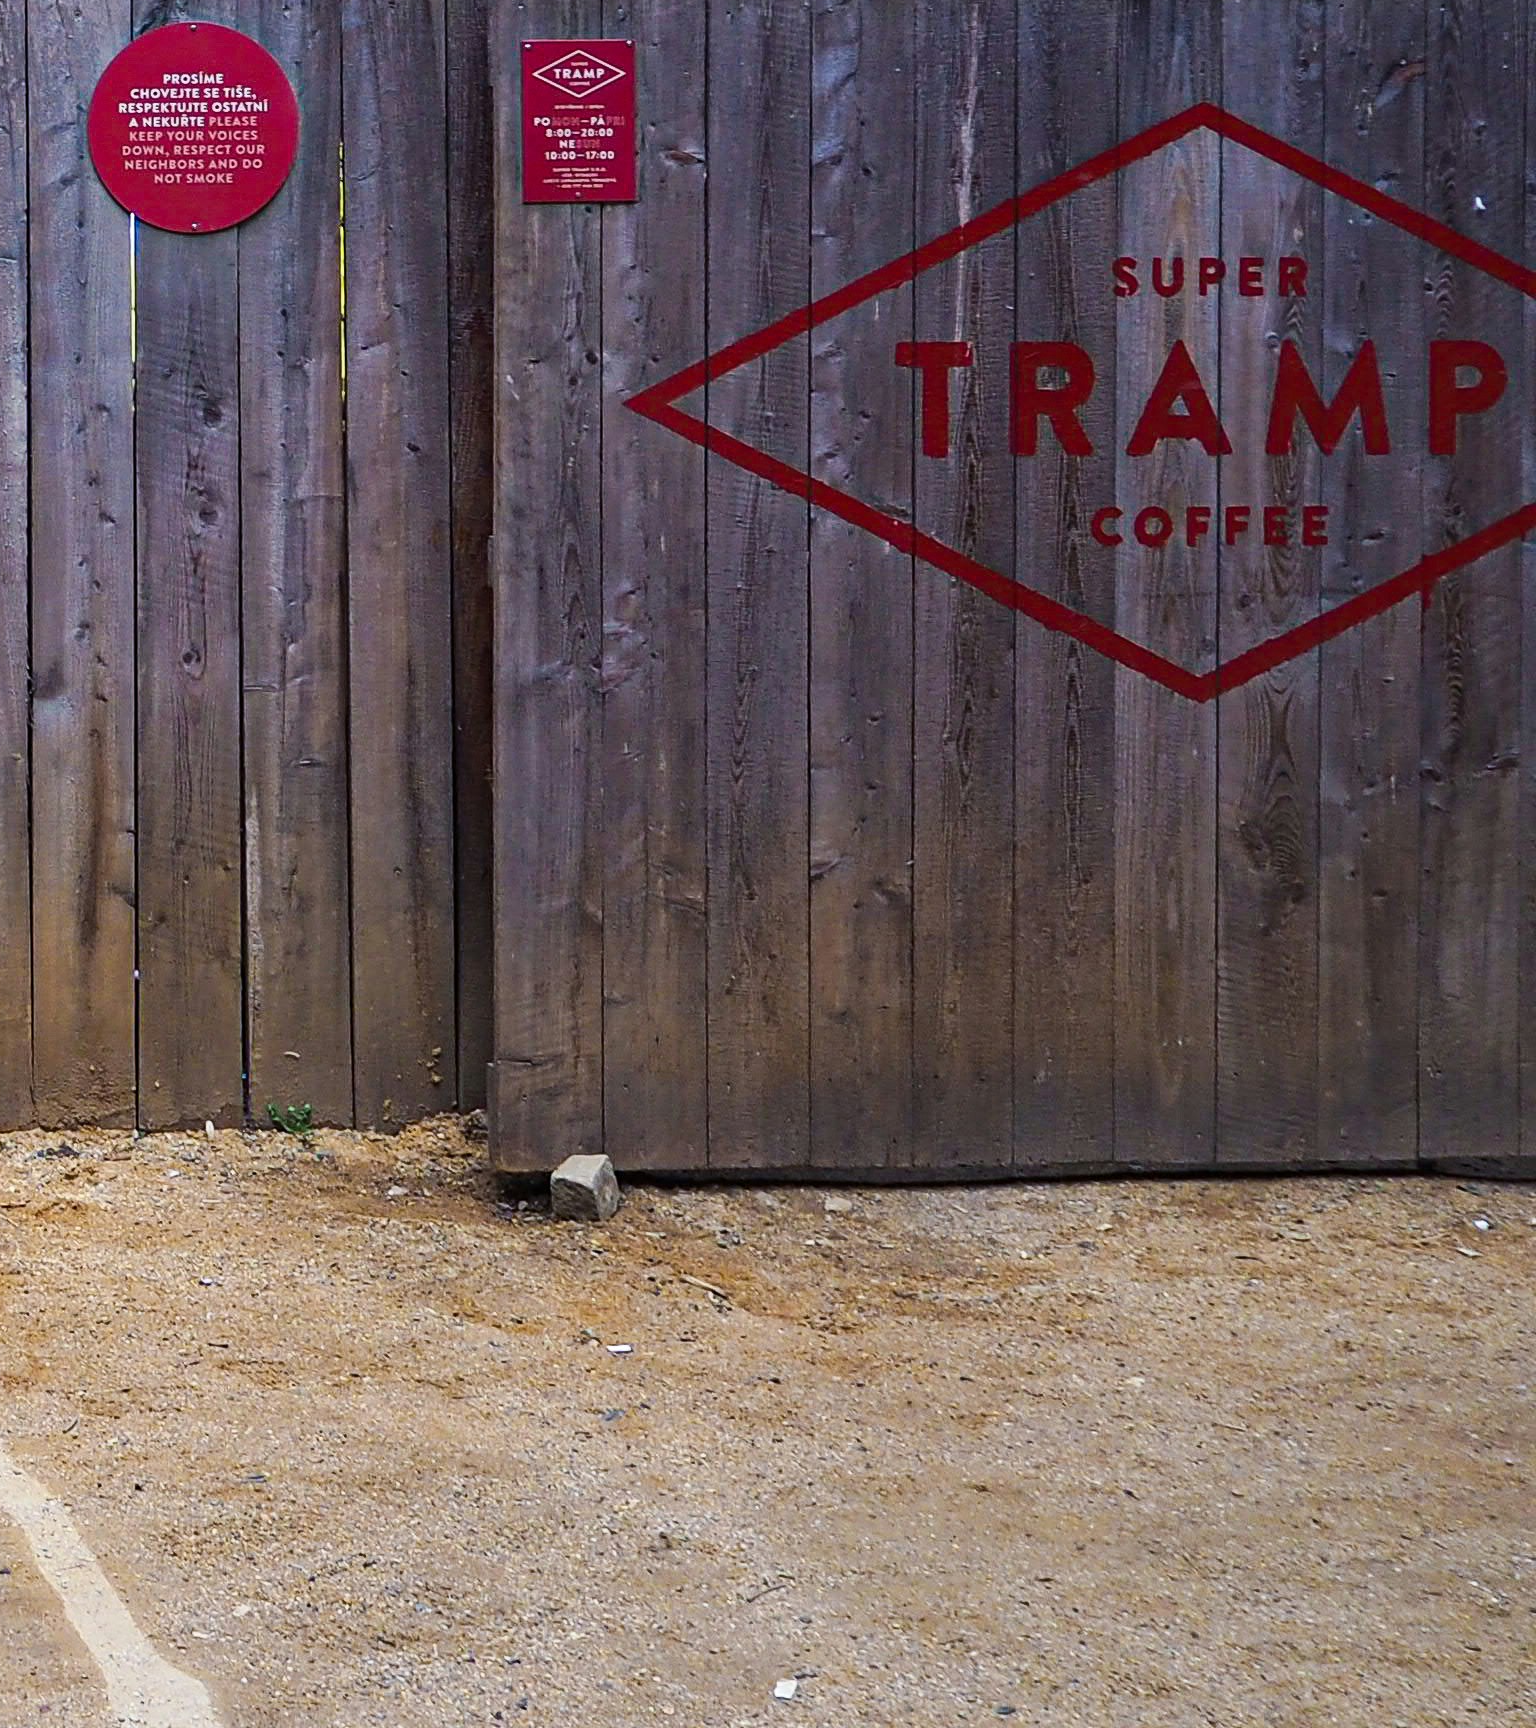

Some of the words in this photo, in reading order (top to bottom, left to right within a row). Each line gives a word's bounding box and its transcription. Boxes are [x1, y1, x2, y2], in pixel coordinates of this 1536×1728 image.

[163, 71, 224, 84] PROSÍME
[553, 68, 605, 79] TRAMP
[130, 88, 200, 99] CHOVEJTE
[203, 88, 220, 99] SE
[223, 85, 257, 100] TIŠE,
[118, 103, 208, 113] RESPEKTUJTE
[212, 99, 268, 113] OSTATNÍ
[129, 118, 139, 127] A
[142, 114, 205, 127] NEKUŘTE
[209, 116, 257, 127] PLEASE
[129, 131, 163, 142] KEEP
[167, 131, 204, 141] YOUR
[208, 130, 259, 141] VOICES
[122, 145, 170, 158] DOWN,
[174, 144, 232, 156] RESPECT
[235, 144, 265, 155] OUR
[124, 159, 205, 170] NEIGHBORS
[209, 158, 238, 170] AND
[242, 158, 263, 169] DO
[154, 173, 183, 184] NOT
[187, 173, 234, 184] SMOKE
[1112, 256, 1310, 298] SUPER
[895, 339, 1509, 458] TRAMP
[1090, 505, 1330, 548] COFFEE
